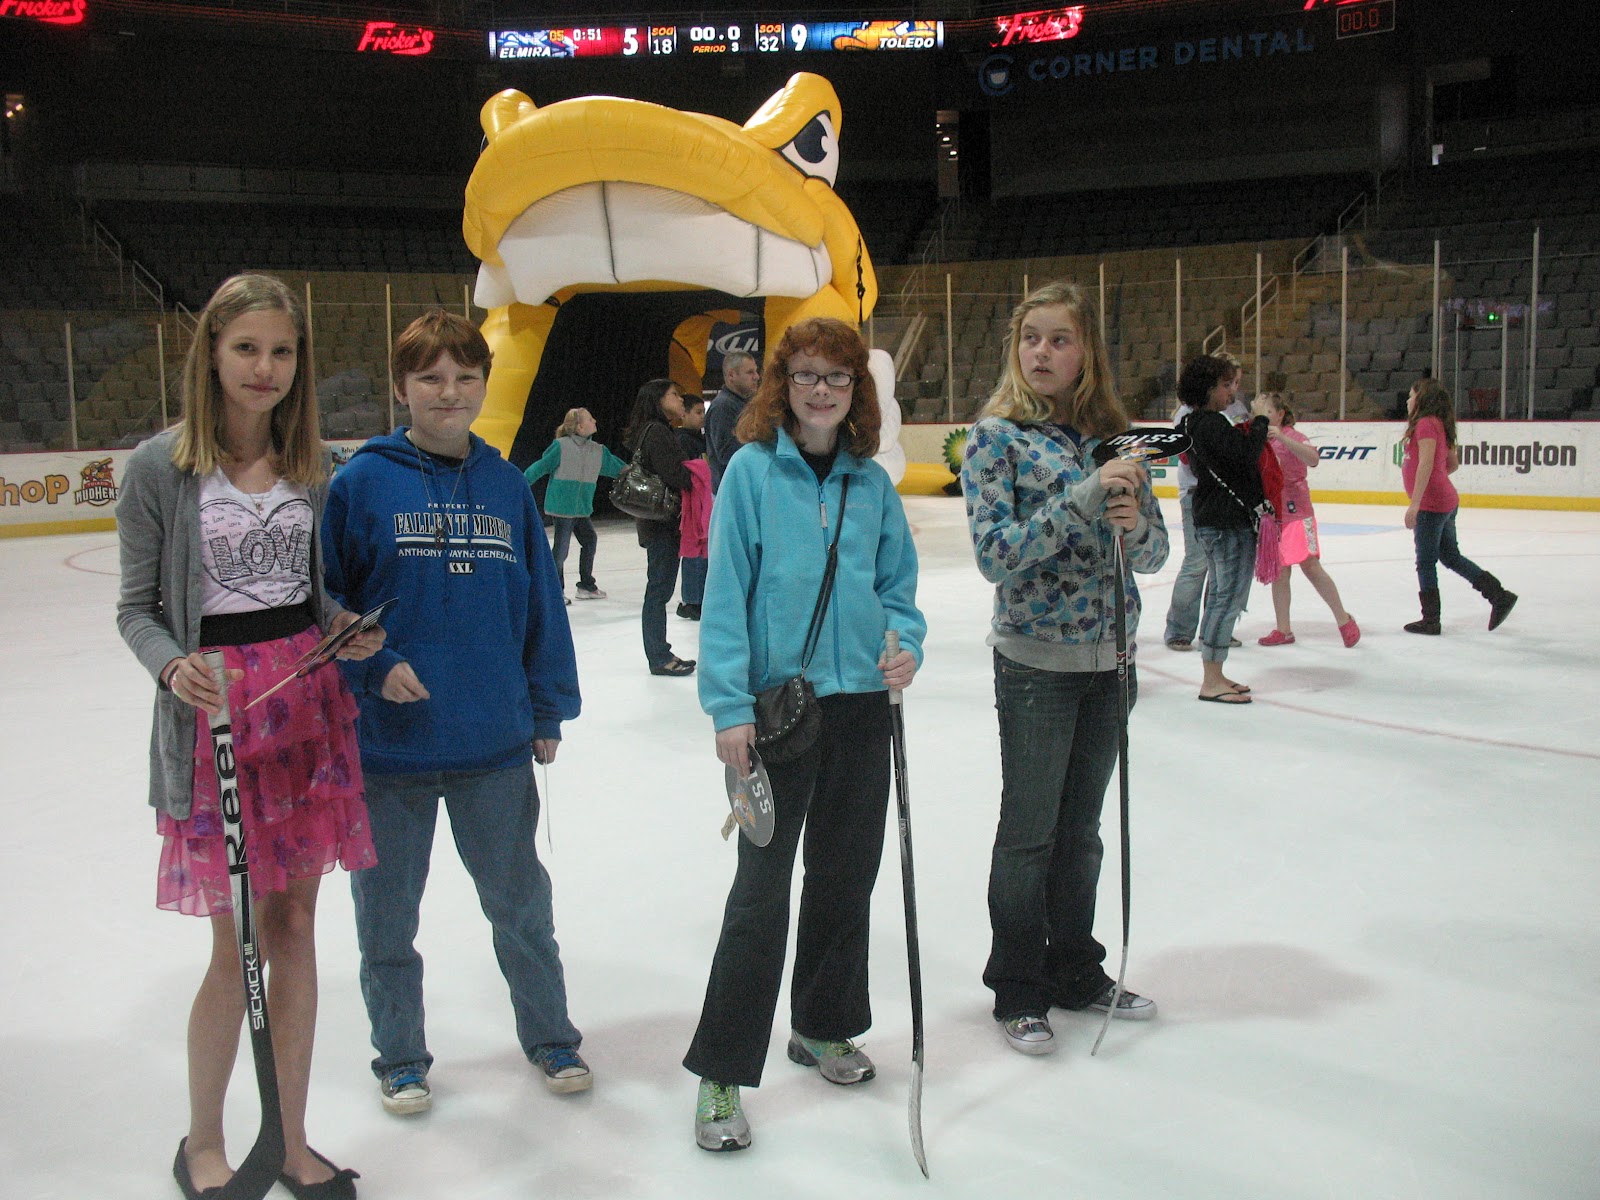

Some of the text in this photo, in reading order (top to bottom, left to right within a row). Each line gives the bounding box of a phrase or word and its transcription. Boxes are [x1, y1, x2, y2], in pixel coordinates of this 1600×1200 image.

[0, 0, 87, 24] Frickers
[573, 28, 602, 41] 0:51
[690, 25, 741, 41] 00.0
[759, 23, 782, 33] SOG
[622, 28, 639, 55] 5
[759, 36, 780, 52] 32
[790, 23, 808, 51] 9
[879, 37, 935, 49] TOLEDO
[499, 46, 551, 59] ELMIRA
[653, 38, 673, 54] 18
[692, 42, 740, 53] PERIOD 3
[1027, 28, 1314, 81] CORNER DENTAL
[398, 548, 443, 557] ANTHONY
[449, 562, 473, 573] XXL
[246, 957, 265, 1031] SICKICK
